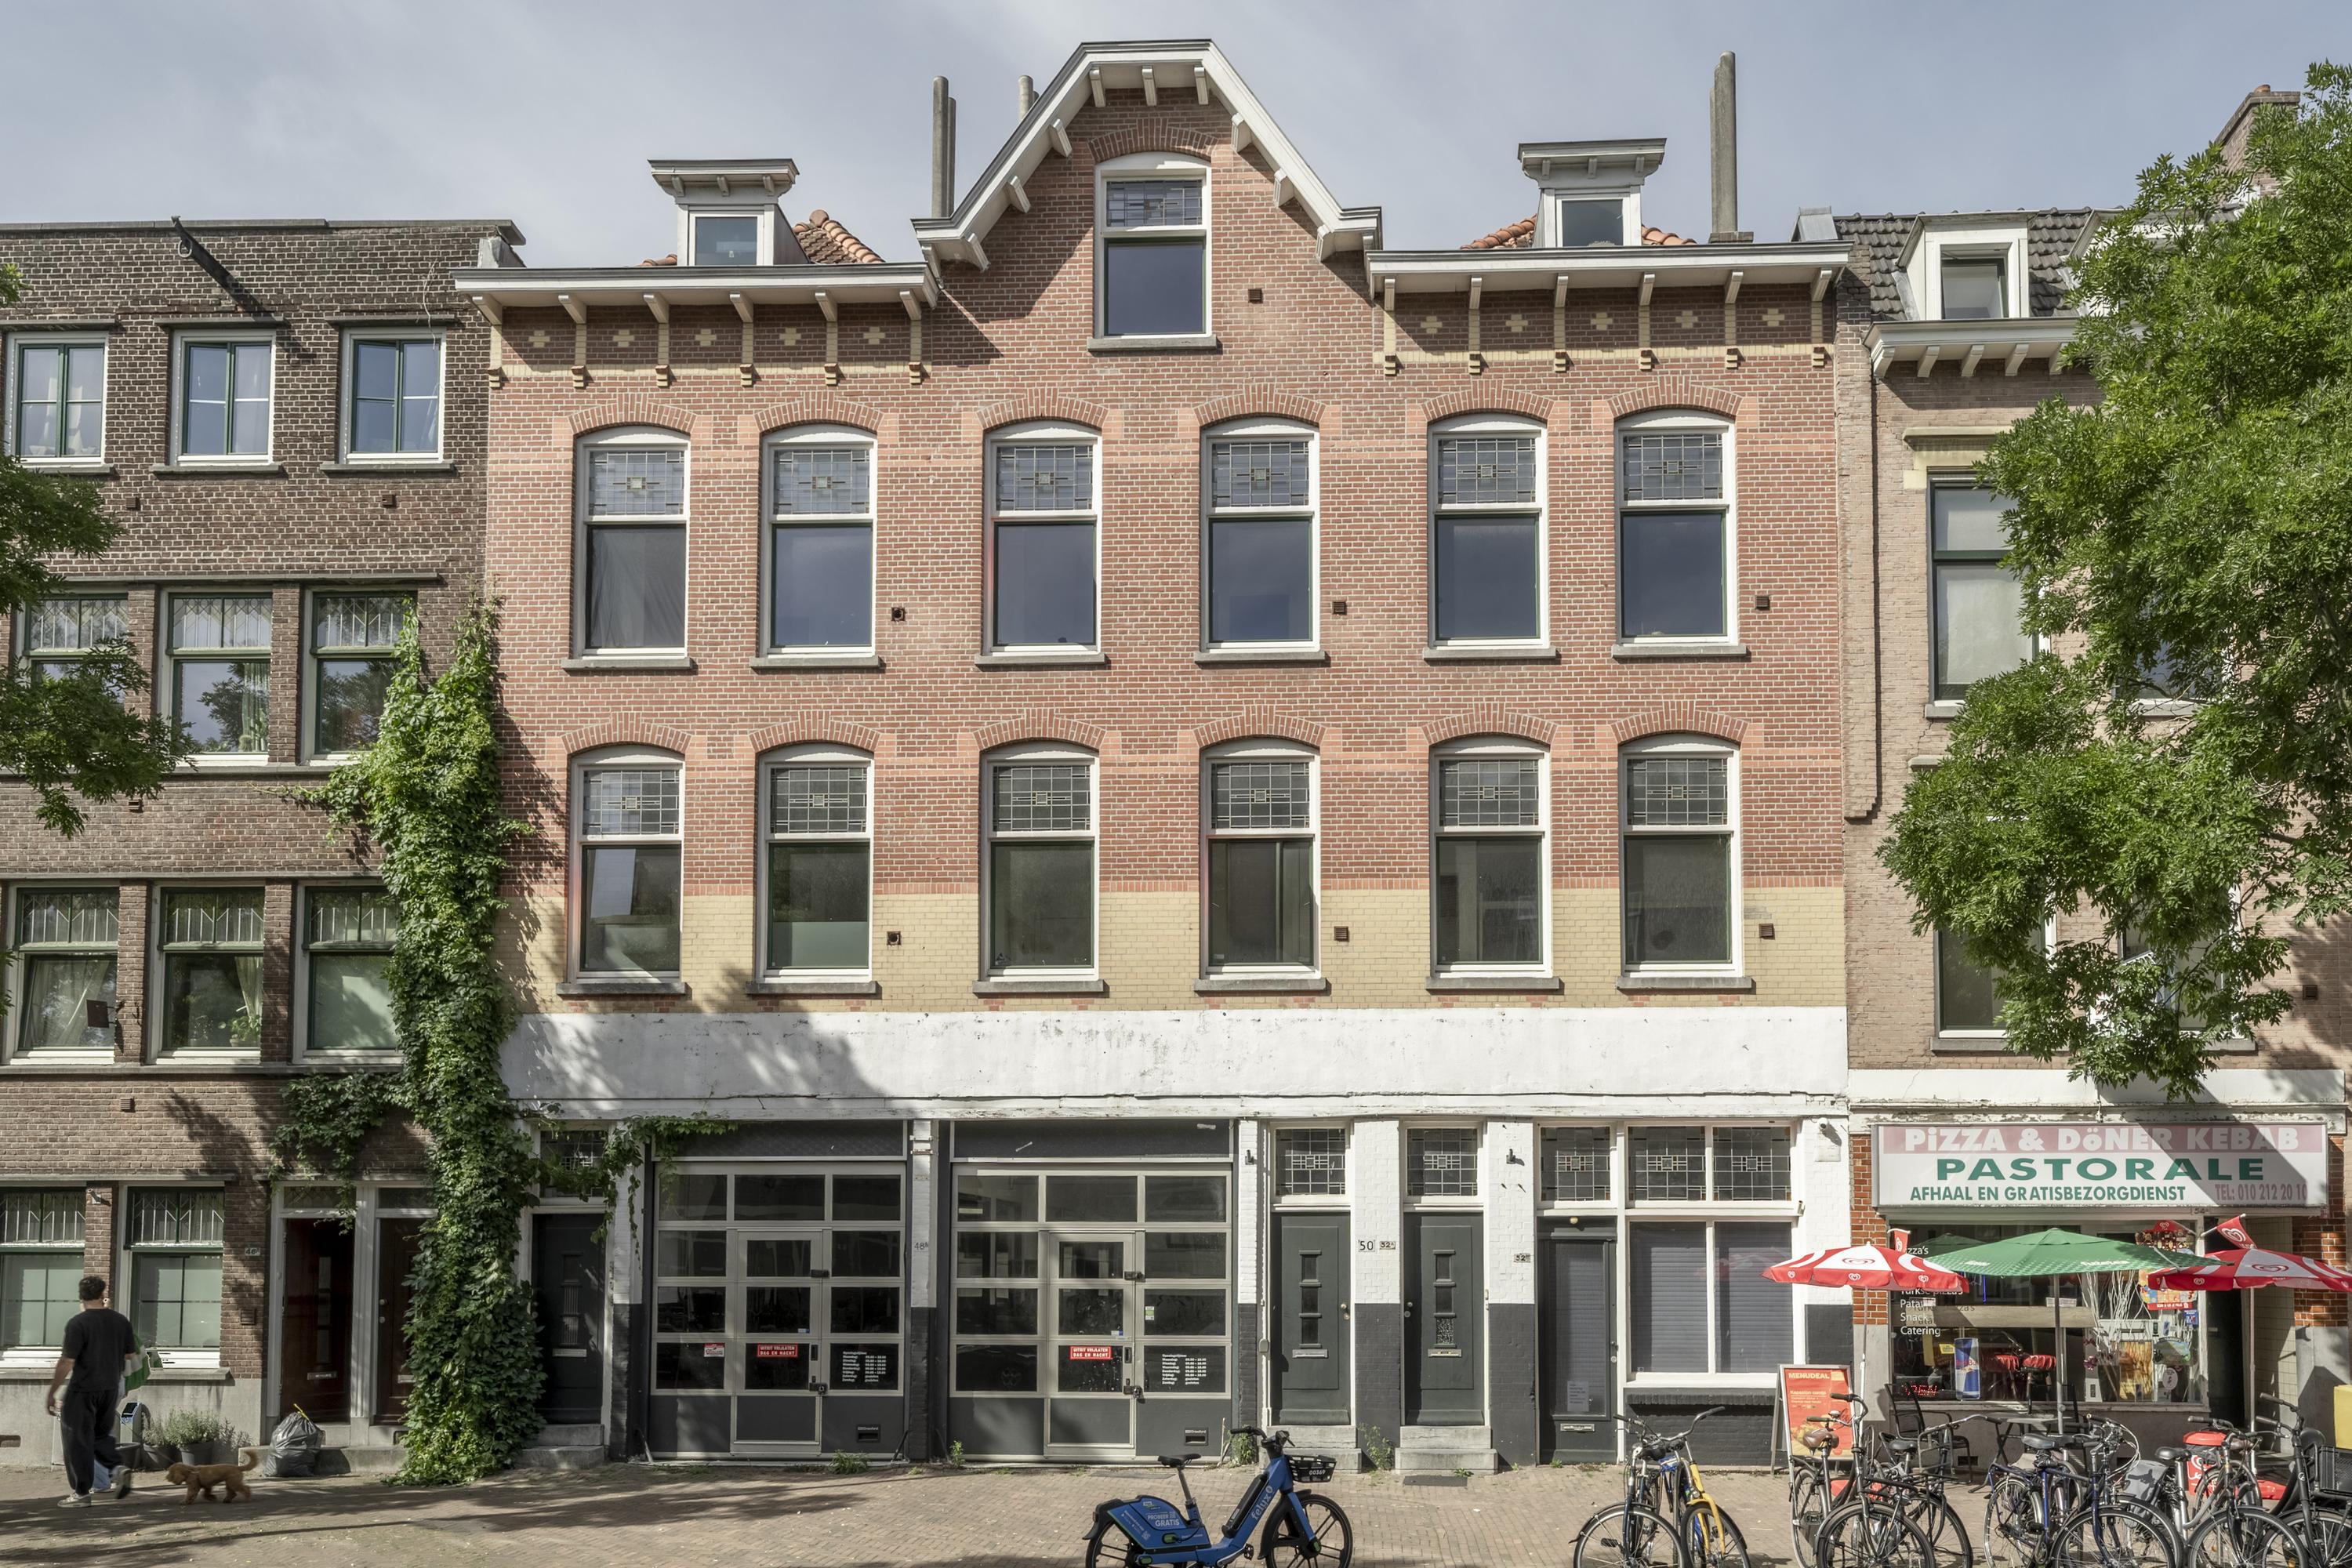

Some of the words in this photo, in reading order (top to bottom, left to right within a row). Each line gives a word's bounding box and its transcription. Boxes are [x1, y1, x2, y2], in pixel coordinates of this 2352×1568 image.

[2018, 1127, 2045, 1151] &
[2187, 1127, 2299, 1150] KEBAB
[1937, 1158, 2263, 1181] PASTORALE
[1910, 1186, 1973, 1200] AFHAAL
[1978, 1186, 1998, 1200] EN
[2004, 1185, 2186, 1201] GRATISBEZORGDIENST
[2215, 1184, 2234, 1201] TEL:
[2238, 1184, 2256, 1201] 010
[2259, 1184, 2278, 1201] 212
[2280, 1184, 2292, 1201] 20
[2296, 1184, 2307, 1201] 10
[1359, 1240, 1374, 1250] 50
[1900, 1326, 1941, 1338] Catering
